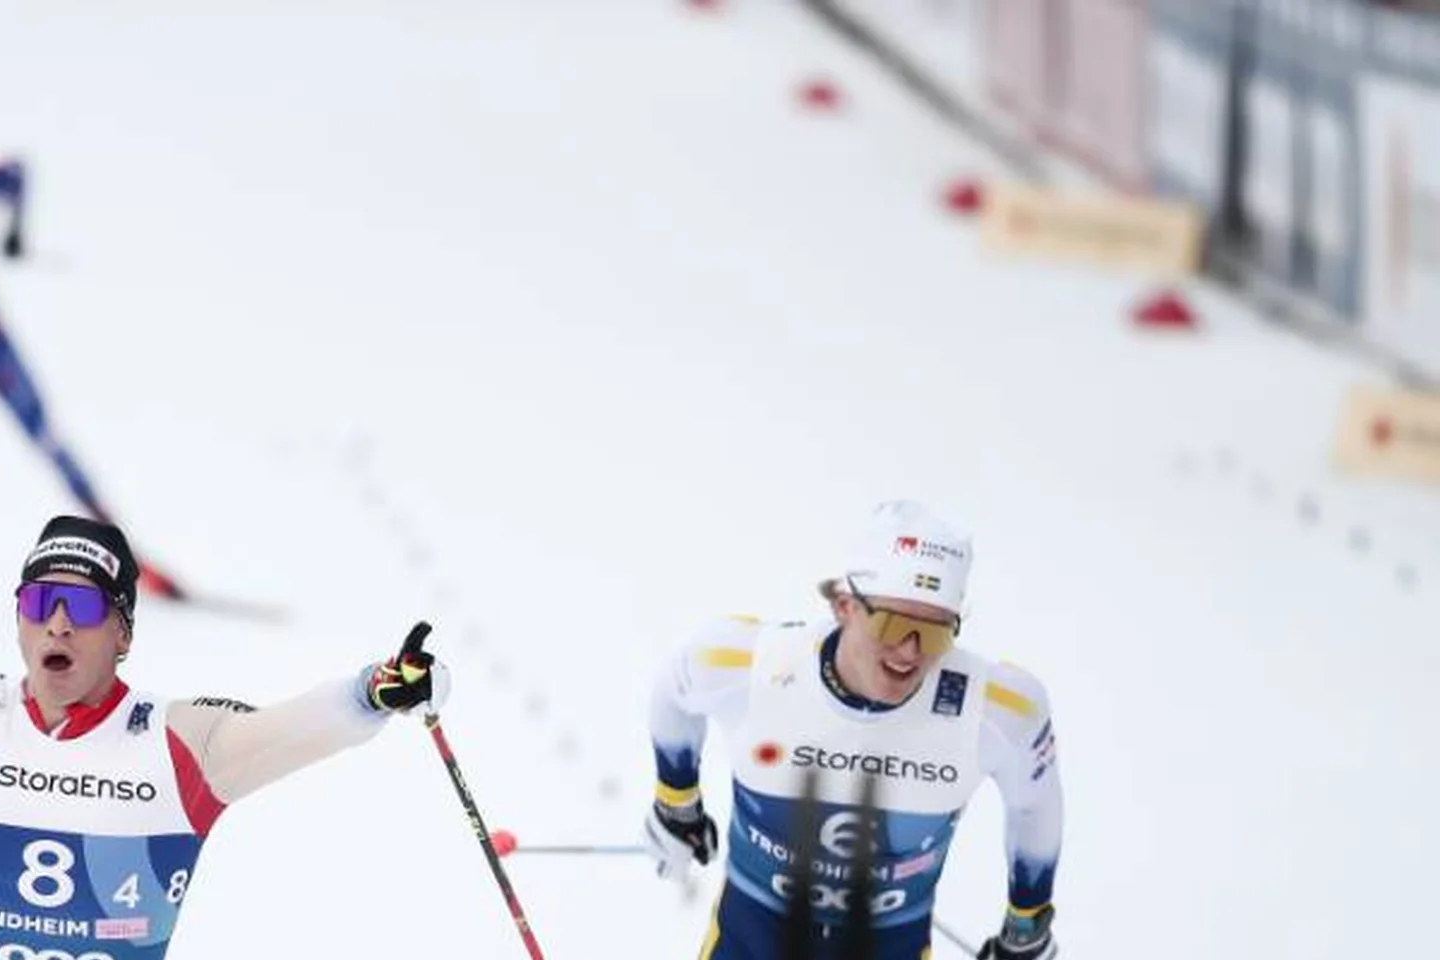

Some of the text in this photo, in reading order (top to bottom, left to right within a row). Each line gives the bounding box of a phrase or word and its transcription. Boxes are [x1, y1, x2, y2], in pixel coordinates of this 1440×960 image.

[791, 745, 959, 783] StoraEnso
[18, 839, 189, 909] 8 4 8
